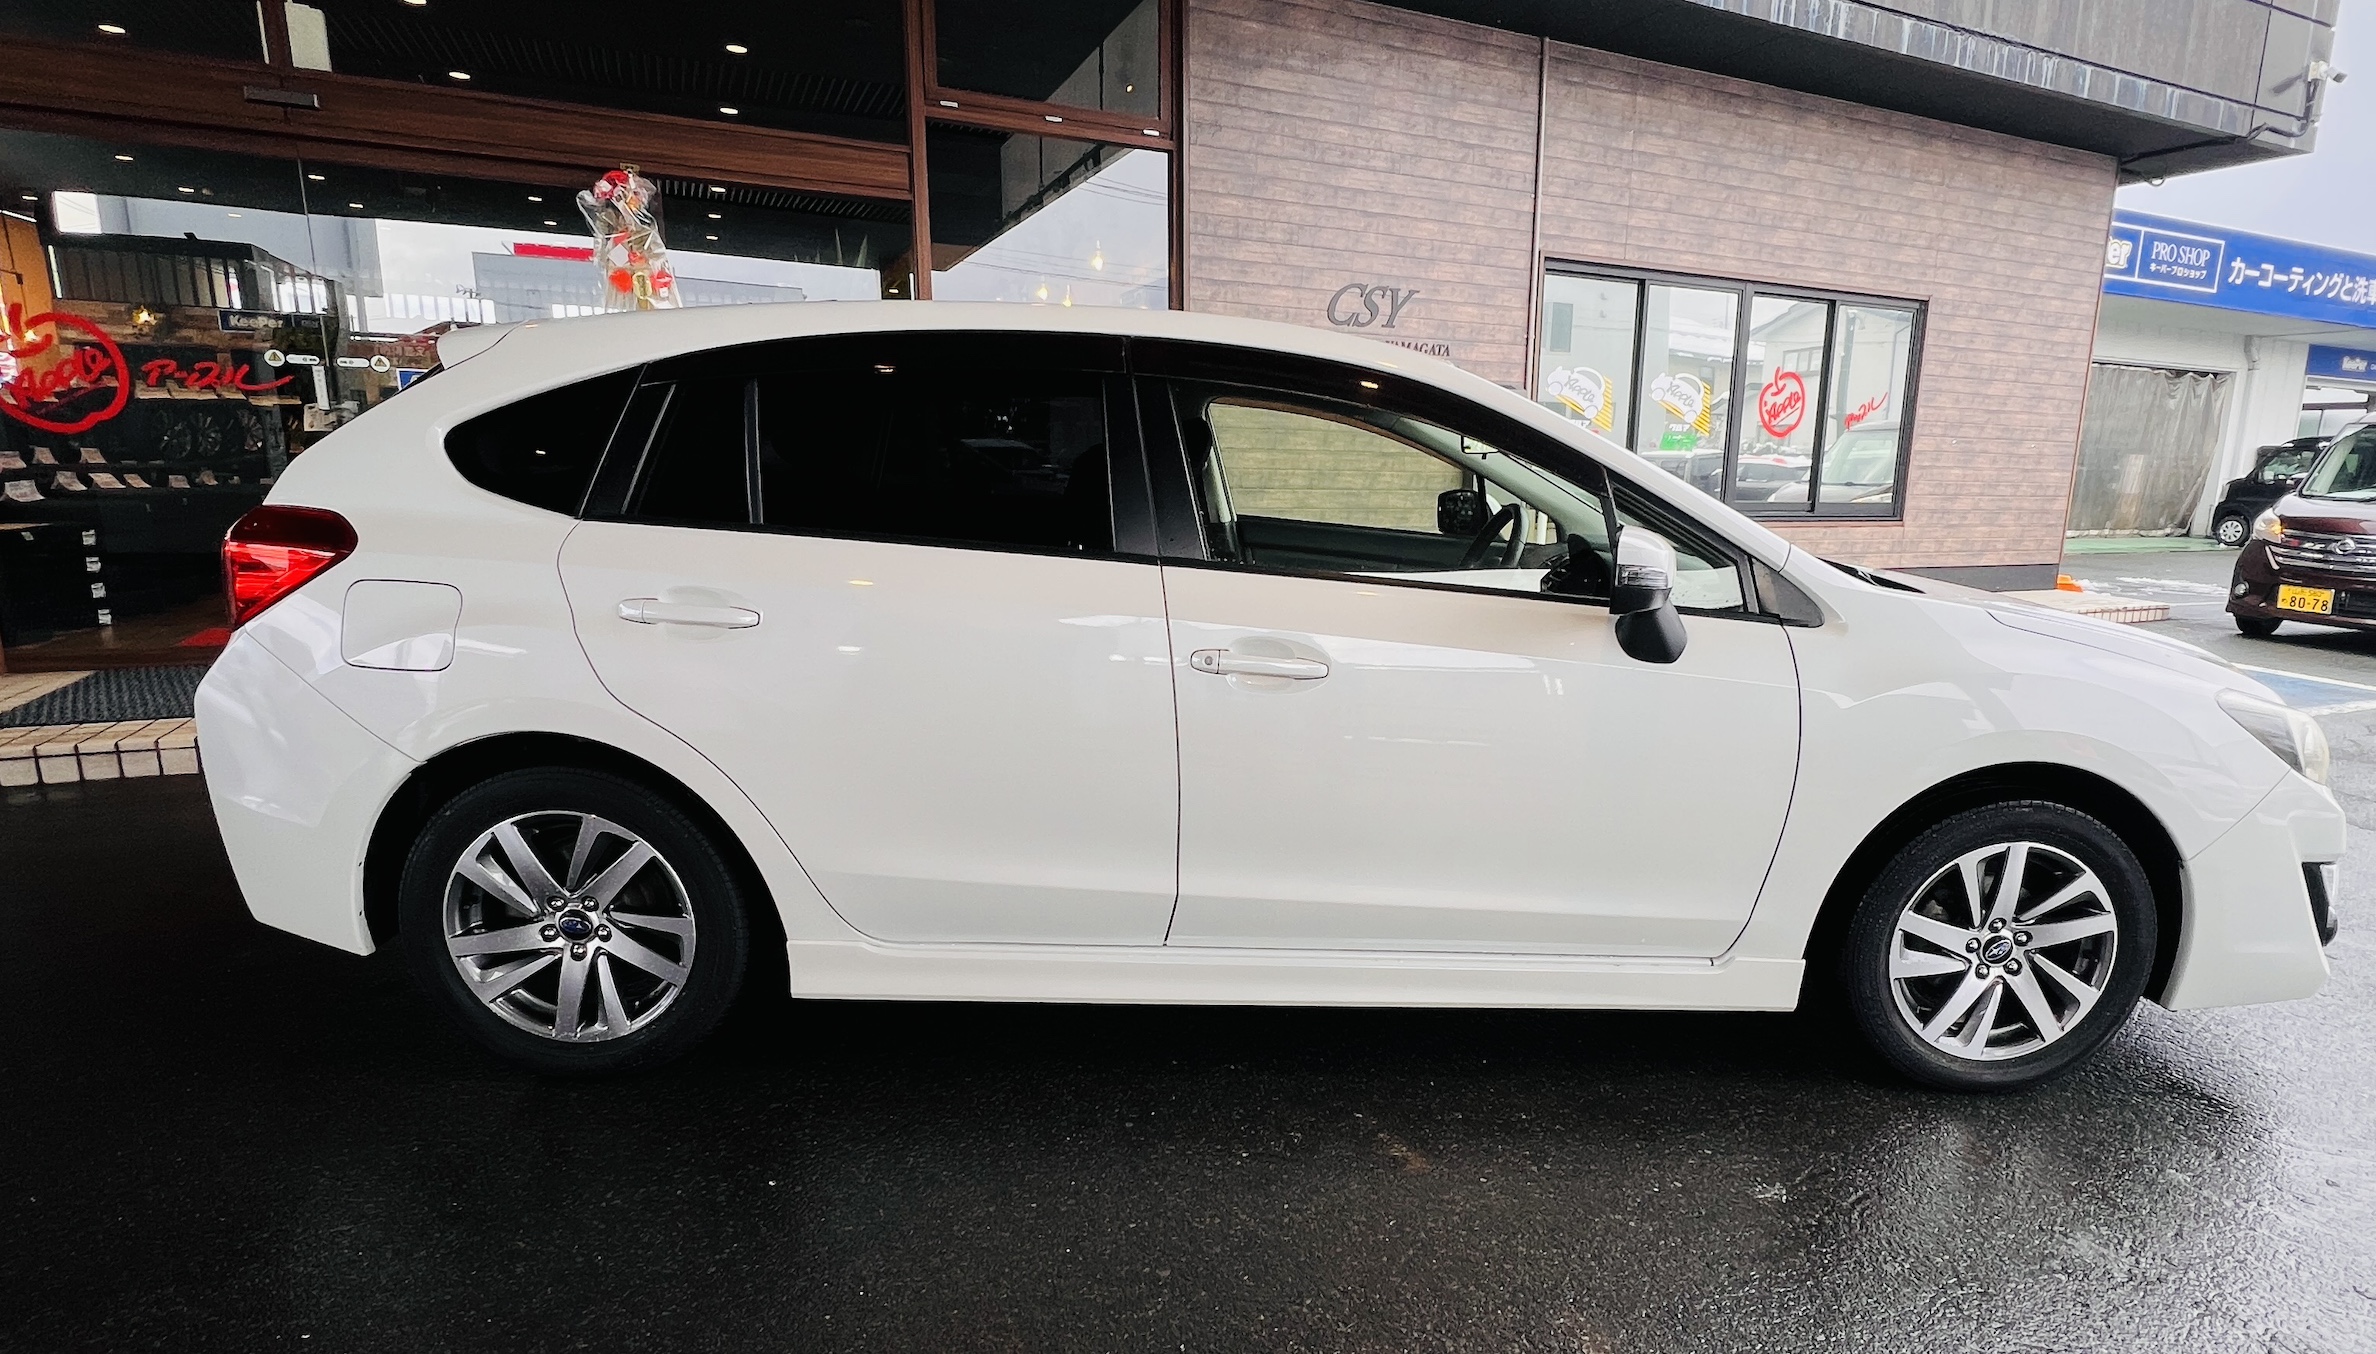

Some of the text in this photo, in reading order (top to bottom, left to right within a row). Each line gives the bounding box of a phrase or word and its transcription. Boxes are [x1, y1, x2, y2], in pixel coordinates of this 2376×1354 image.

[2106, 238, 2133, 268] er
[2151, 241, 2211, 267] PRO SHOP
[2149, 262, 2208, 280] キーパープロショップ
[1327, 283, 1420, 329] CSY
[229, 315, 284, 329] KeePer
[1385, 340, 1450, 356] MAGATA
[2289, 596, 2329, 611] 80-78
